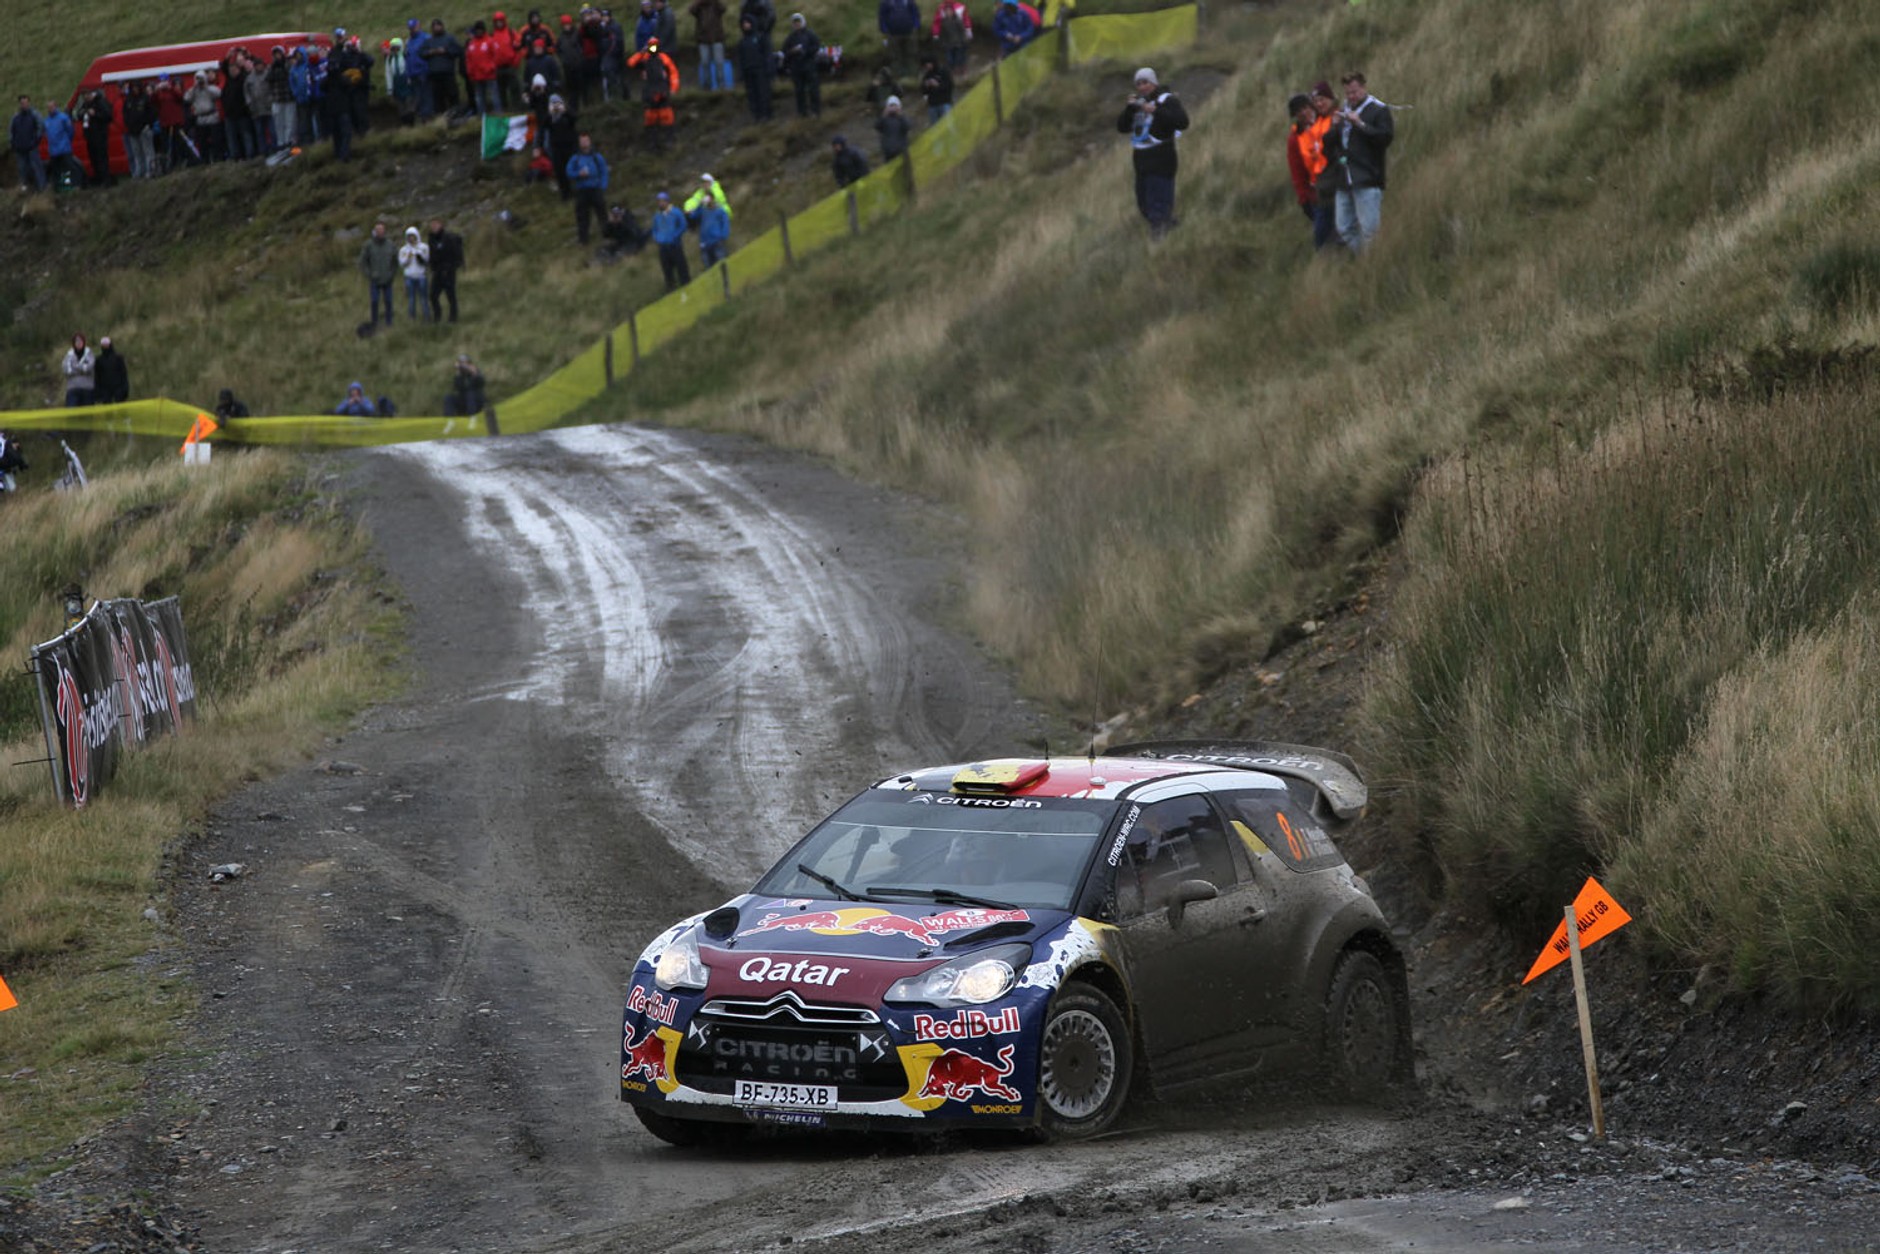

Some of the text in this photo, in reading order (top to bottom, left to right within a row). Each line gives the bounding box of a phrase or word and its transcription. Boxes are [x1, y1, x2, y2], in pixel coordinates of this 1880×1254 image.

[1276, 811, 1302, 862] 8
[1594, 900, 1609, 915] GB
[739, 957, 850, 987] Qatar
[741, 1083, 829, 1106] BF-735-XB
[764, 1113, 821, 1124] MICHELIN
[977, 1104, 1019, 1114] MONROE
